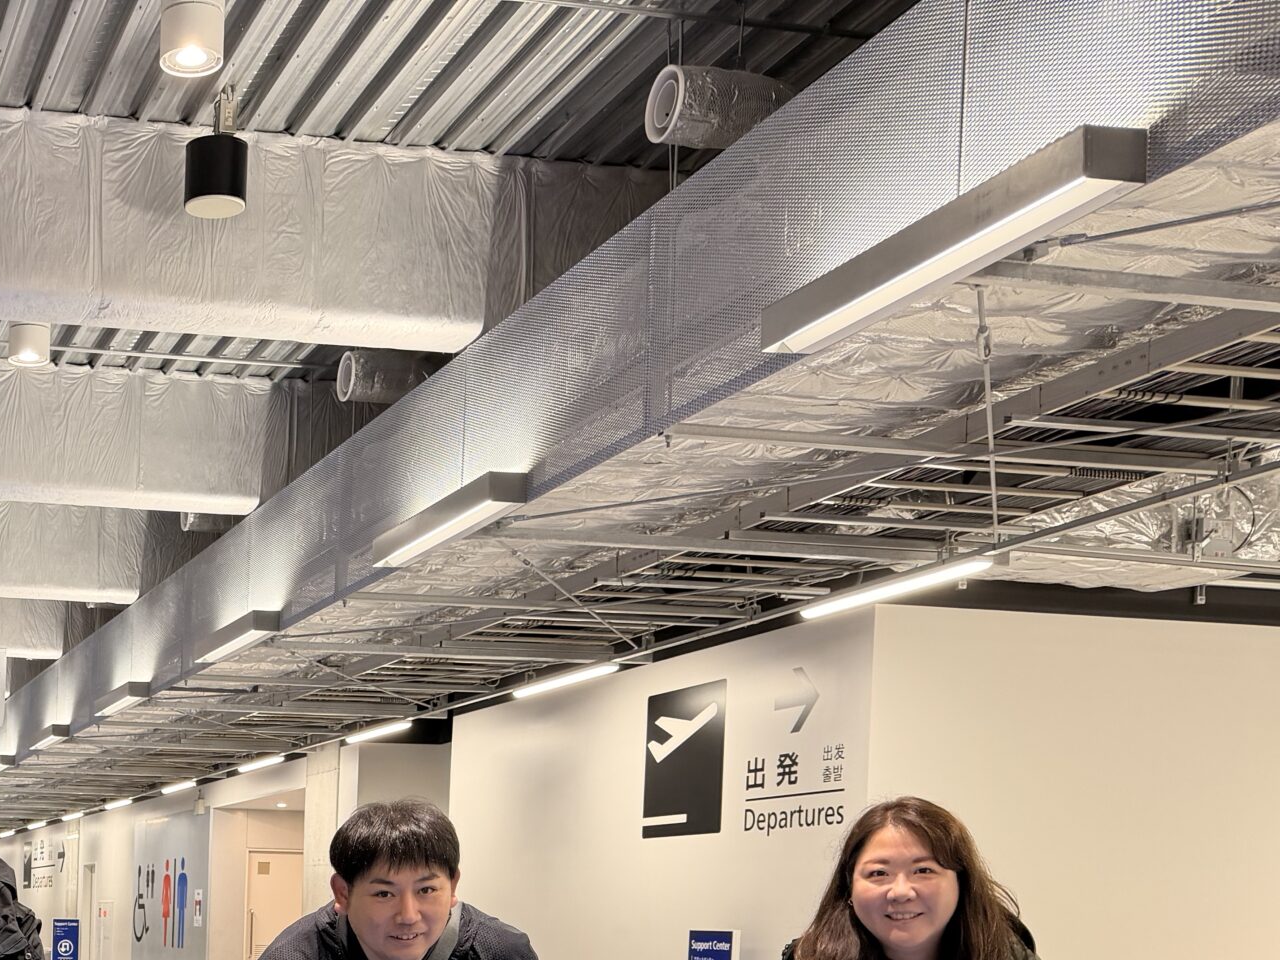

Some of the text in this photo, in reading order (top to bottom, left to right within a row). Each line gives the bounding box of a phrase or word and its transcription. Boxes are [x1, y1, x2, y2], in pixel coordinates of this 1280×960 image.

[822, 743, 845, 761] 出发
[745, 752, 799, 791] 出発
[822, 764, 843, 783] 출발
[743, 804, 845, 836] Departures
[691, 940, 731, 952] Support Center
